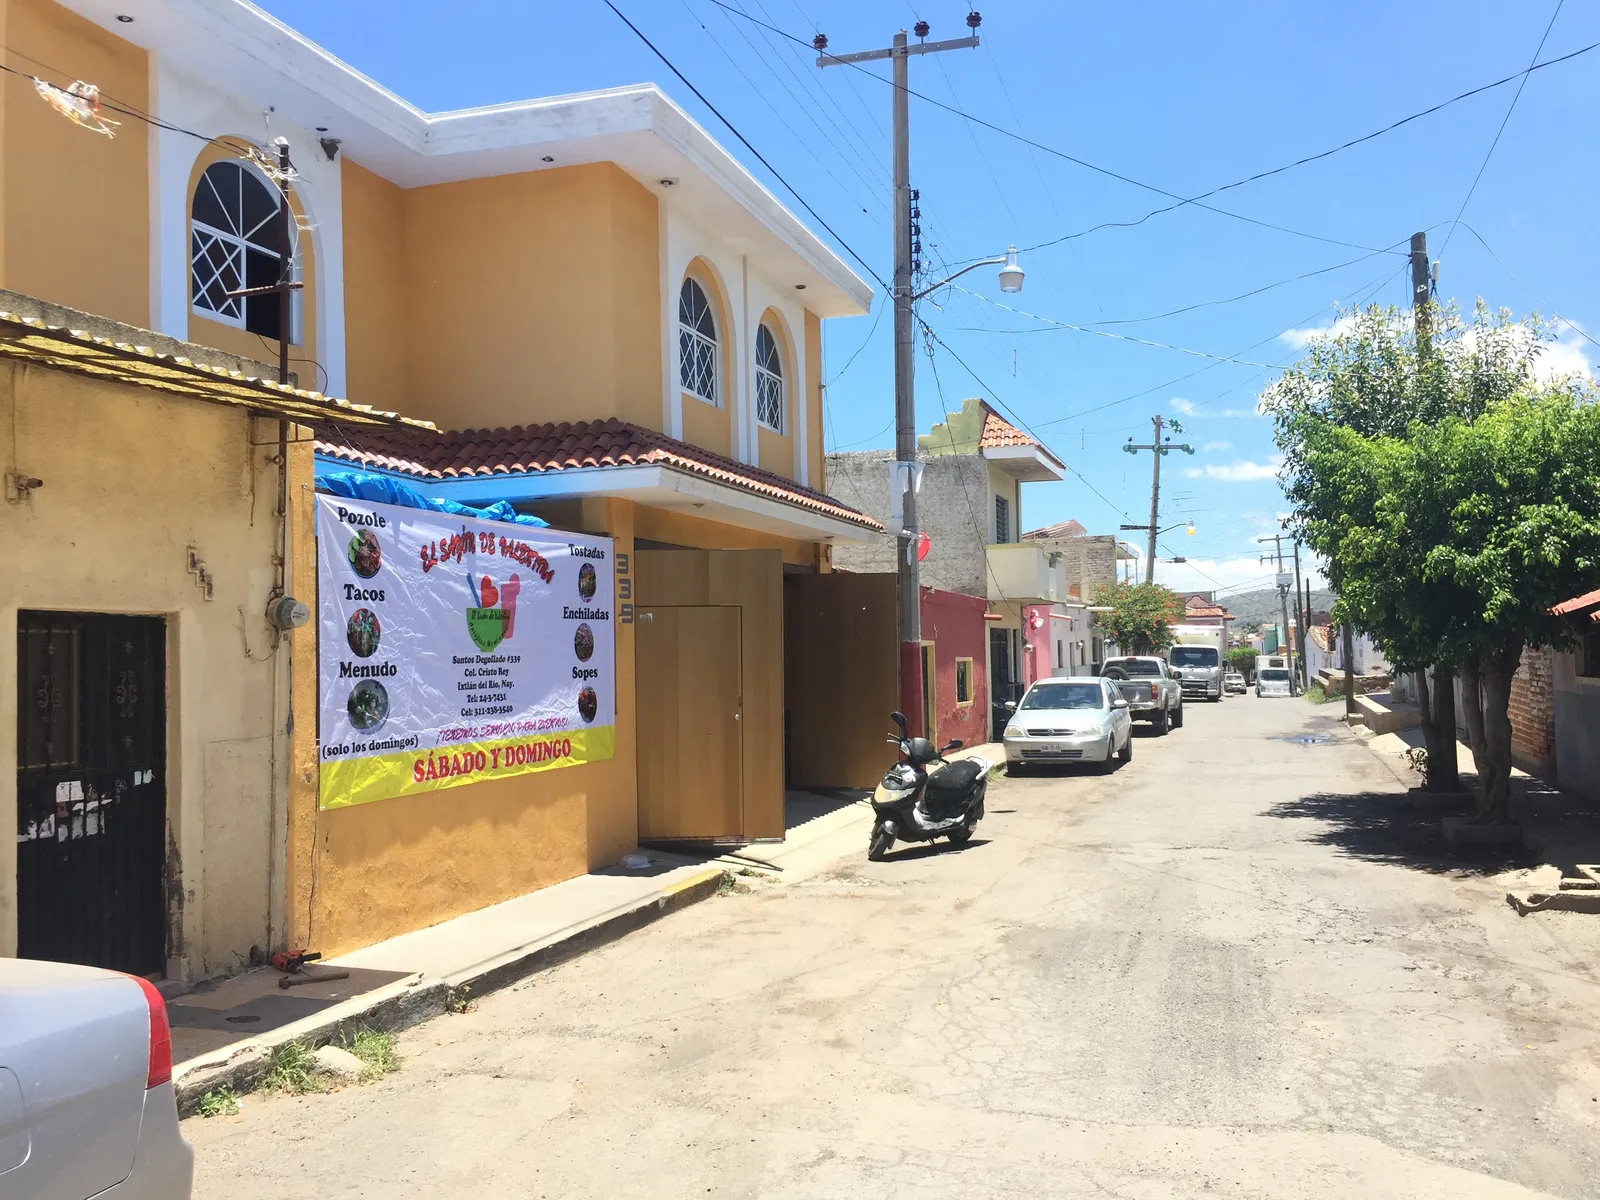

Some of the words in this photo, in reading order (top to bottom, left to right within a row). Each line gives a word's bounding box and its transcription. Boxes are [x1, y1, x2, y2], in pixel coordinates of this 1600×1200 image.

[338, 506, 386, 528] Pozole
[420, 541, 438, 573] EL
[479, 532, 496, 555] DE
[499, 536, 555, 584] VALENTINA
[568, 543, 605, 560] Tostadas
[343, 583, 385, 602] Tacos
[563, 606, 610, 620] Enchiladas
[452, 655, 475, 664] Santos
[475, 655, 506, 665] Degollado
[507, 655, 521, 663] #339
[339, 661, 397, 678] Menudo
[464, 668, 477, 677] Col.
[478, 668, 497, 676] Cristo
[498, 667, 509, 677] Rey
[572, 666, 598, 681] Sopes
[457, 681, 477, 691] Ixtlán
[478, 681, 487, 689] del
[501, 679, 515, 689] Nay.
[467, 694, 478, 703] Tel:
[461, 708, 473, 717] Cel:
[517, 721, 536, 734] PARA
[322, 743, 349, 759] (solo
[352, 742, 367, 753] los
[369, 734, 419, 750] domingos)
[413, 751, 486, 783] SÁBADO
[490, 748, 502, 769] Y
[504, 738, 572, 767] DOMINGO
